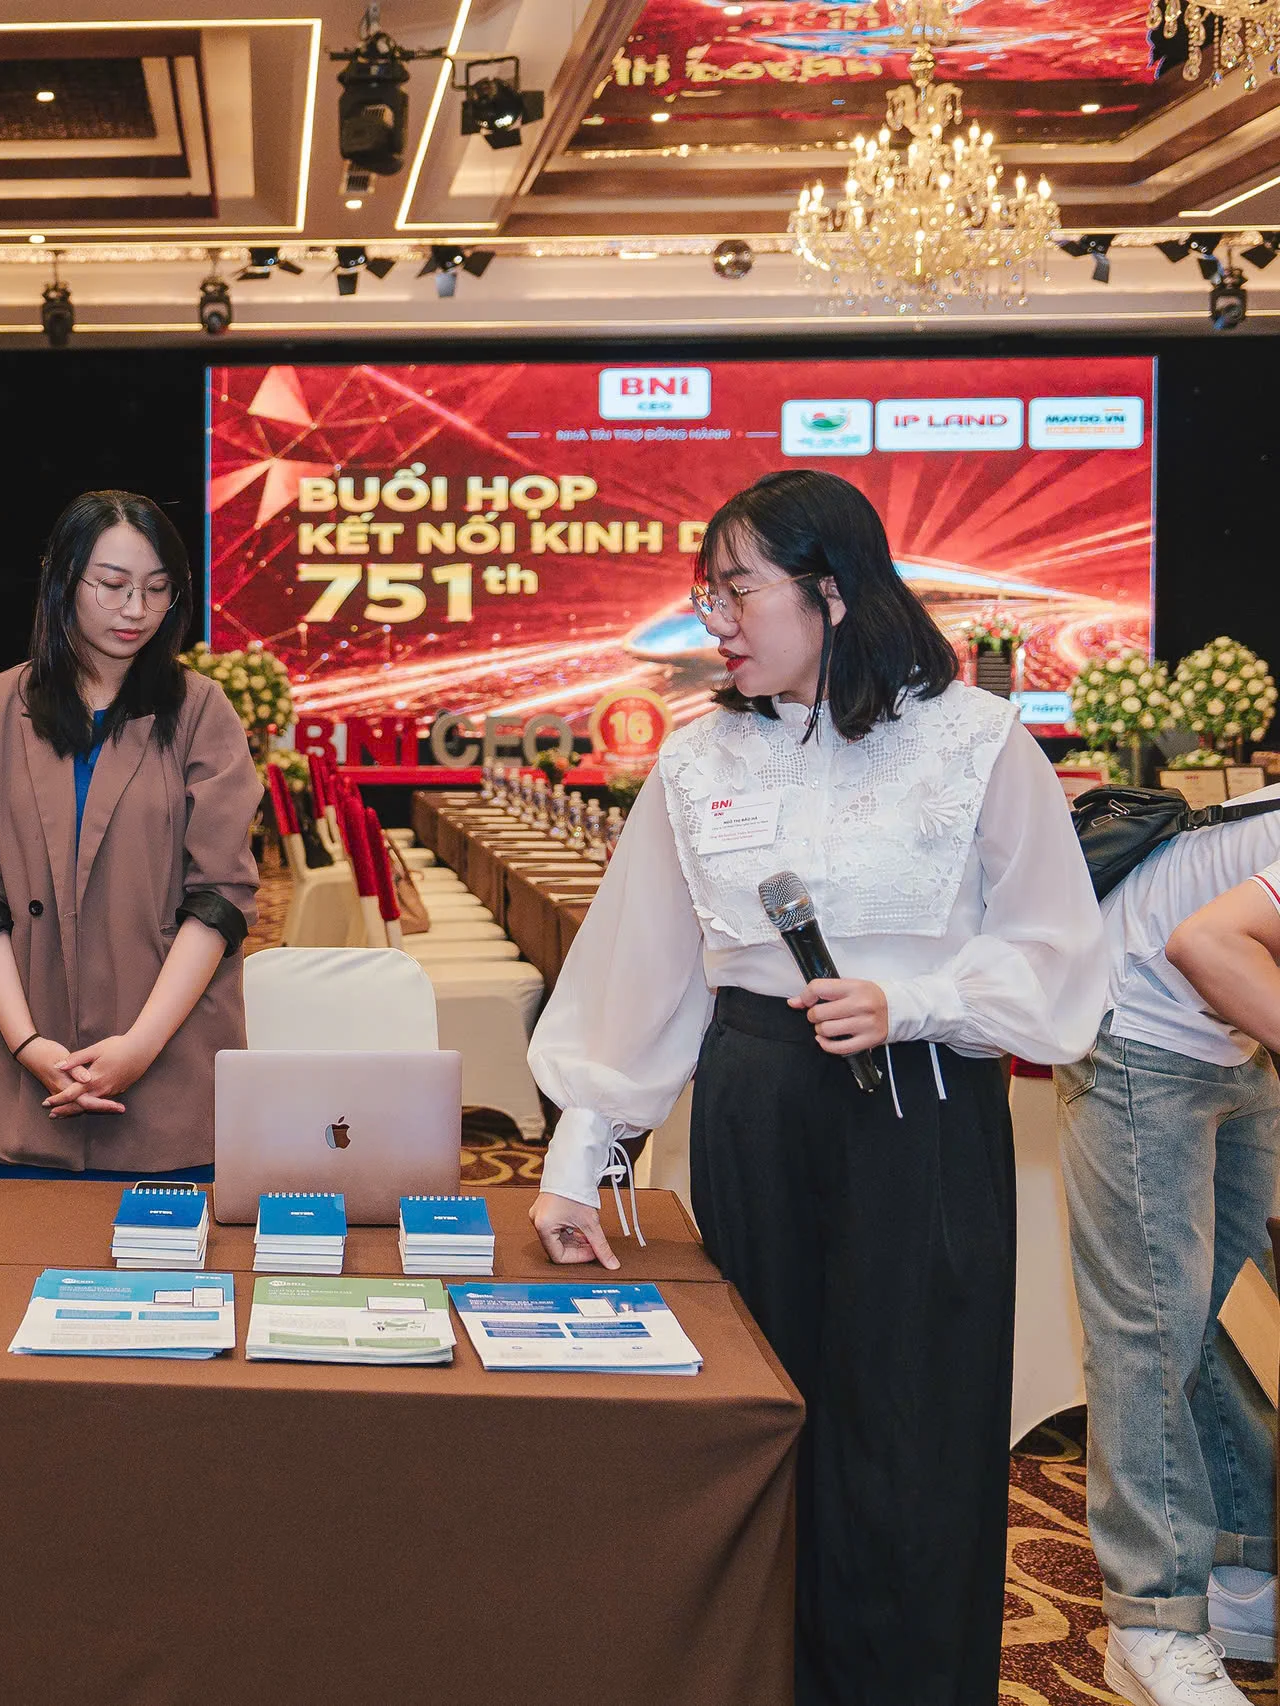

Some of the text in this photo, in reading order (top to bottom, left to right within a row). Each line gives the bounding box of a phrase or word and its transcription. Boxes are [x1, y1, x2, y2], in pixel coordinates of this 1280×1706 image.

[620, 376, 690, 395] BNI
[893, 413, 1008, 428] IP LAND
[299, 462, 598, 520] BUỔI HỌP
[298, 512, 707, 555] KẾT NỐI KINH D
[609, 711, 653, 745] 16
